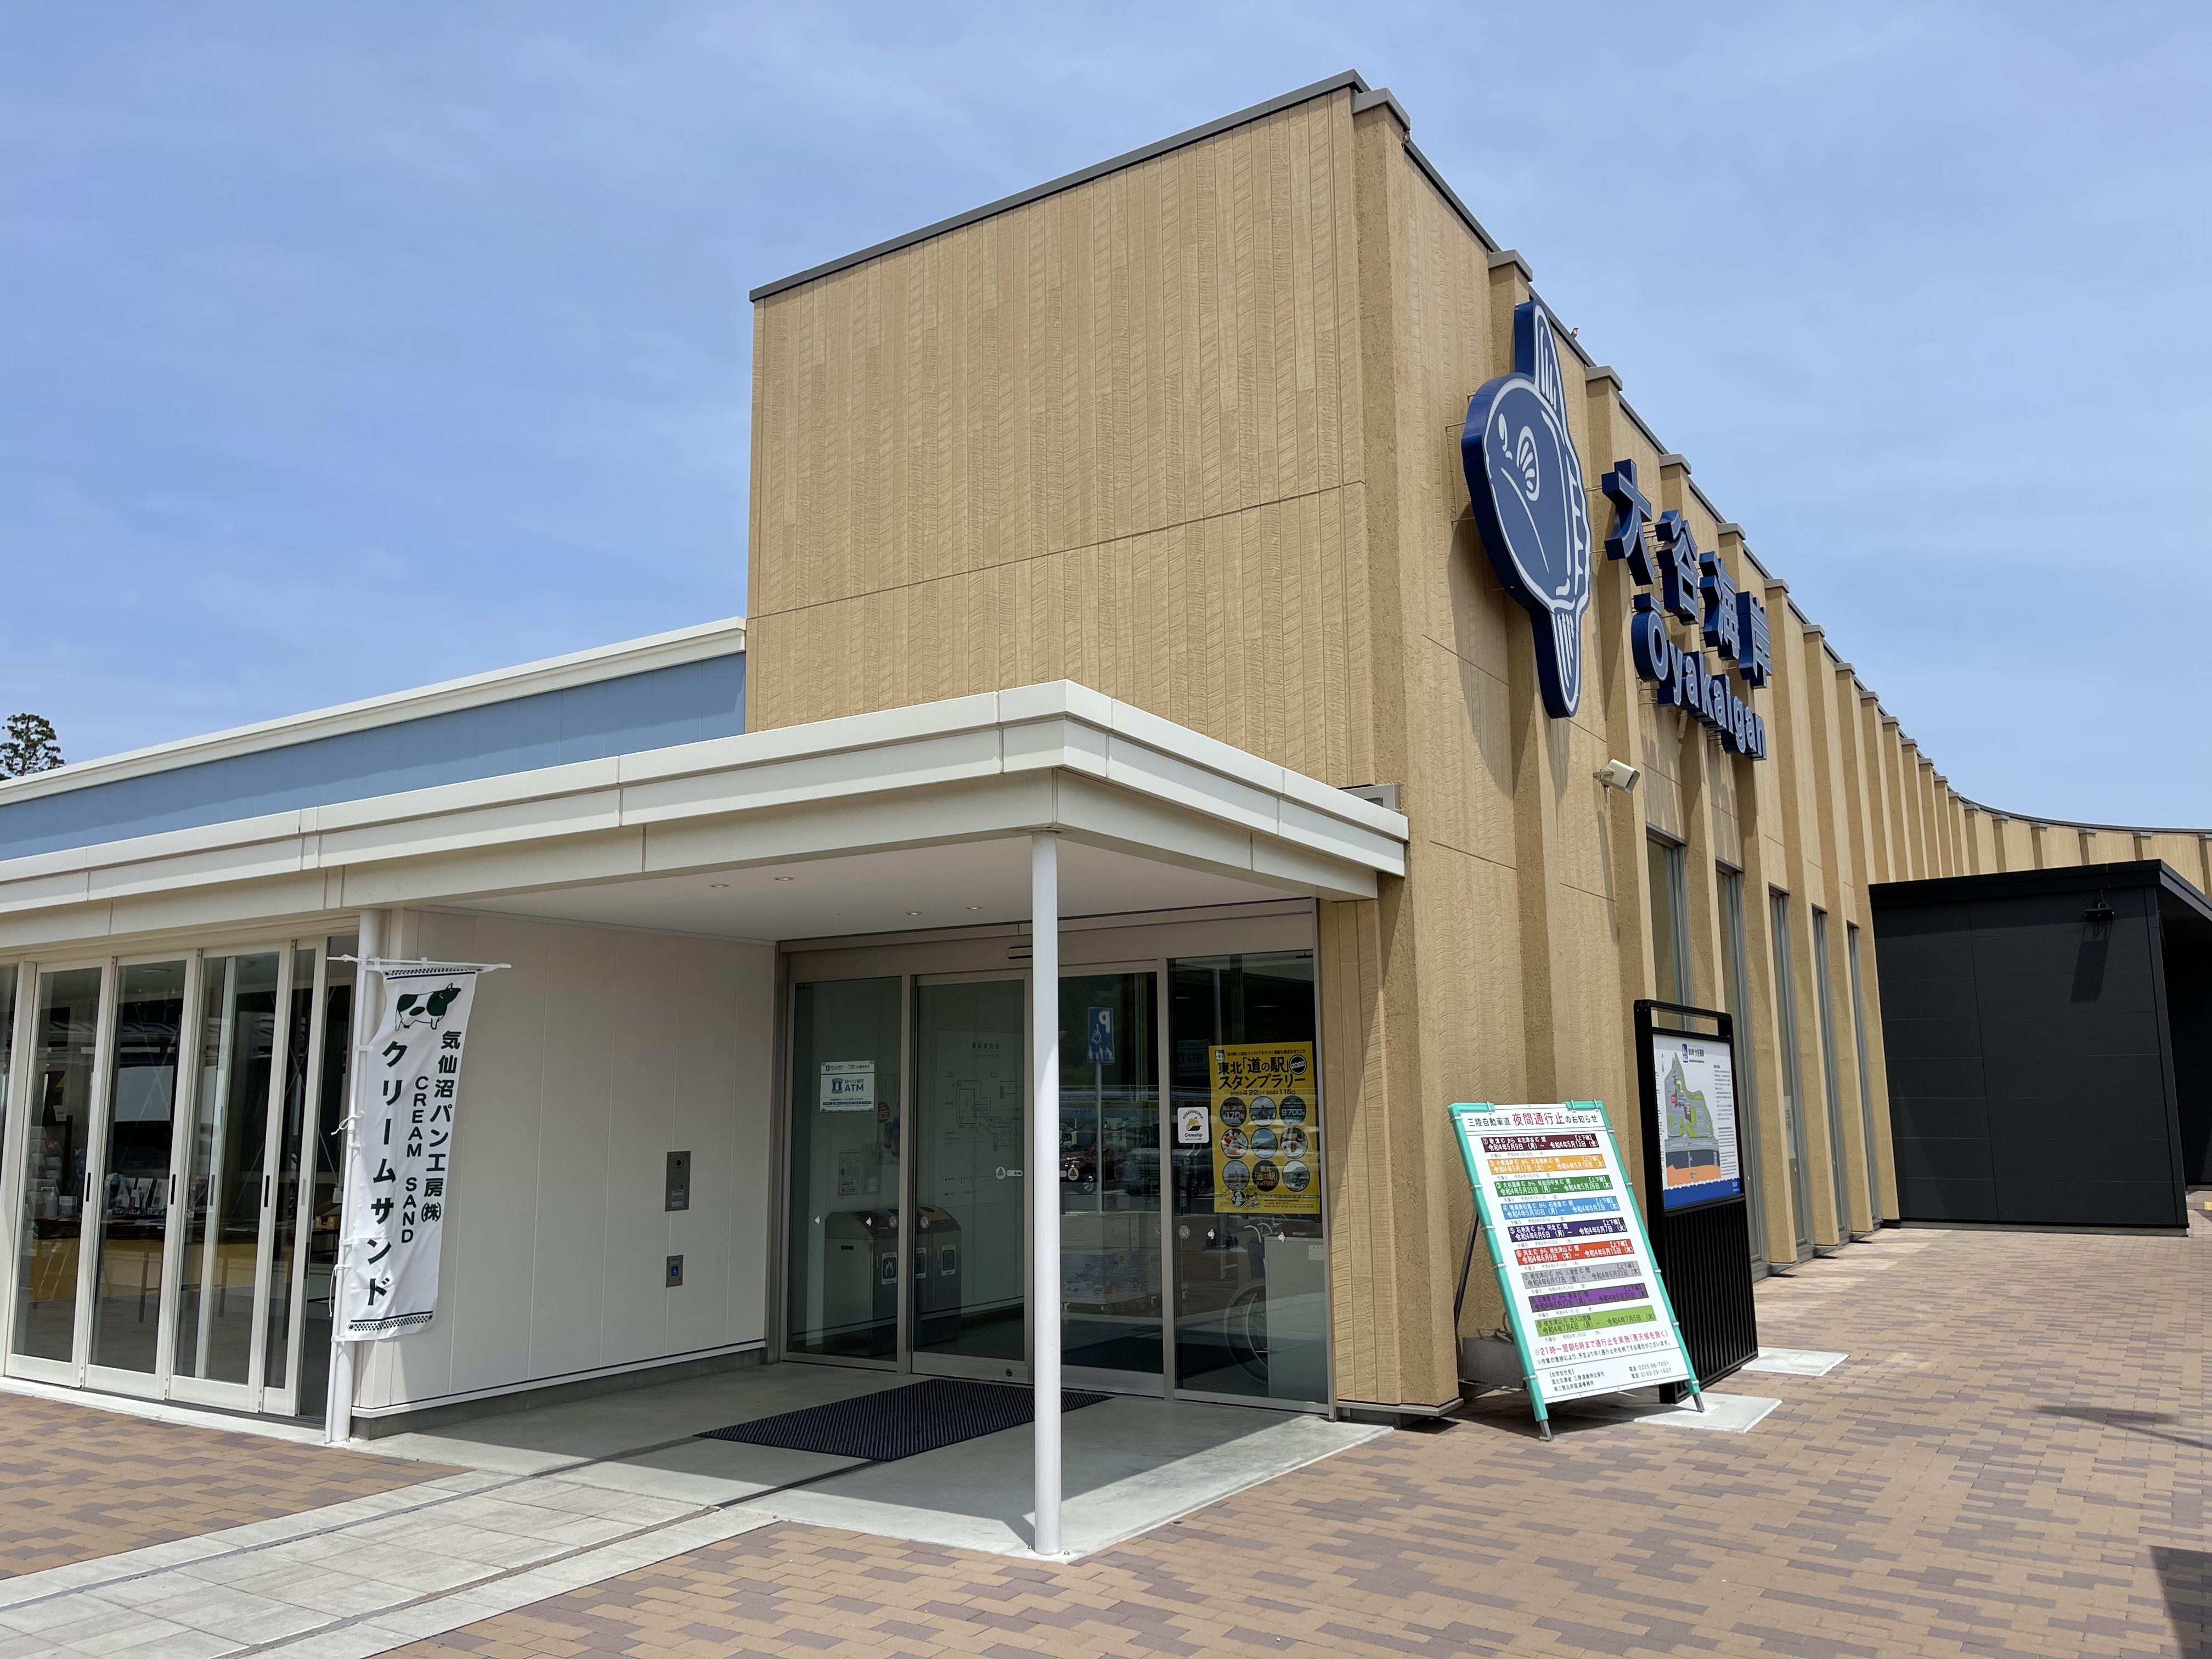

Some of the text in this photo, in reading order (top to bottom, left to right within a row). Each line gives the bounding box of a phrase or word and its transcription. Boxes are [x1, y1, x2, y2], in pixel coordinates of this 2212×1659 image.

[1601, 459, 1772, 689] 大谷海岸
[1218, 1057, 1289, 1075] 東北「道の駅」
[844, 1084, 864, 1092] ATM
[1218, 1073, 1306, 1090] スタンプラリー
[1468, 1112, 1598, 1126] 三陸自動車道 夜間通行止 のお知らせ
[1488, 1143, 1523, 1151] 令和4年5月9日
[1550, 1141, 1587, 1149] 令和4年5月13日
[401, 1076, 429, 1244] CREAM SAND
[1493, 1165, 1532, 1173] 令和4年5月17日
[1557, 1161, 1594, 1170] 令和4年5月19日
[367, 1041, 408, 1306] クリームサンド
[1500, 1187, 1539, 1195] 令和4年5月23日
[1564, 1183, 1600, 1192] 令和4年5月26日
[1506, 1209, 1545, 1218] 令和4年5月30日
[1572, 1204, 1606, 1213] 令和4年6月2日
[1515, 1231, 1551, 1241] 令和4年6月6日
[1555, 1229, 1565, 1238] （月）
[1579, 1225, 1613, 1235] 令和4年6月7日
[1522, 1254, 1558, 1264] 令和4年6月9日
[1584, 1247, 1622, 1257] 令和4年6月15日
[1528, 1276, 1566, 1286] 令和4年6月17日
[1592, 1269, 1628, 1280] 令和4年6月23日
[1535, 1299, 1573, 1310] 令和4年6月27日
[1543, 1323, 1579, 1334] 令和4年7月4日
[1607, 1314, 1641, 1325] 令和4年7月5日
